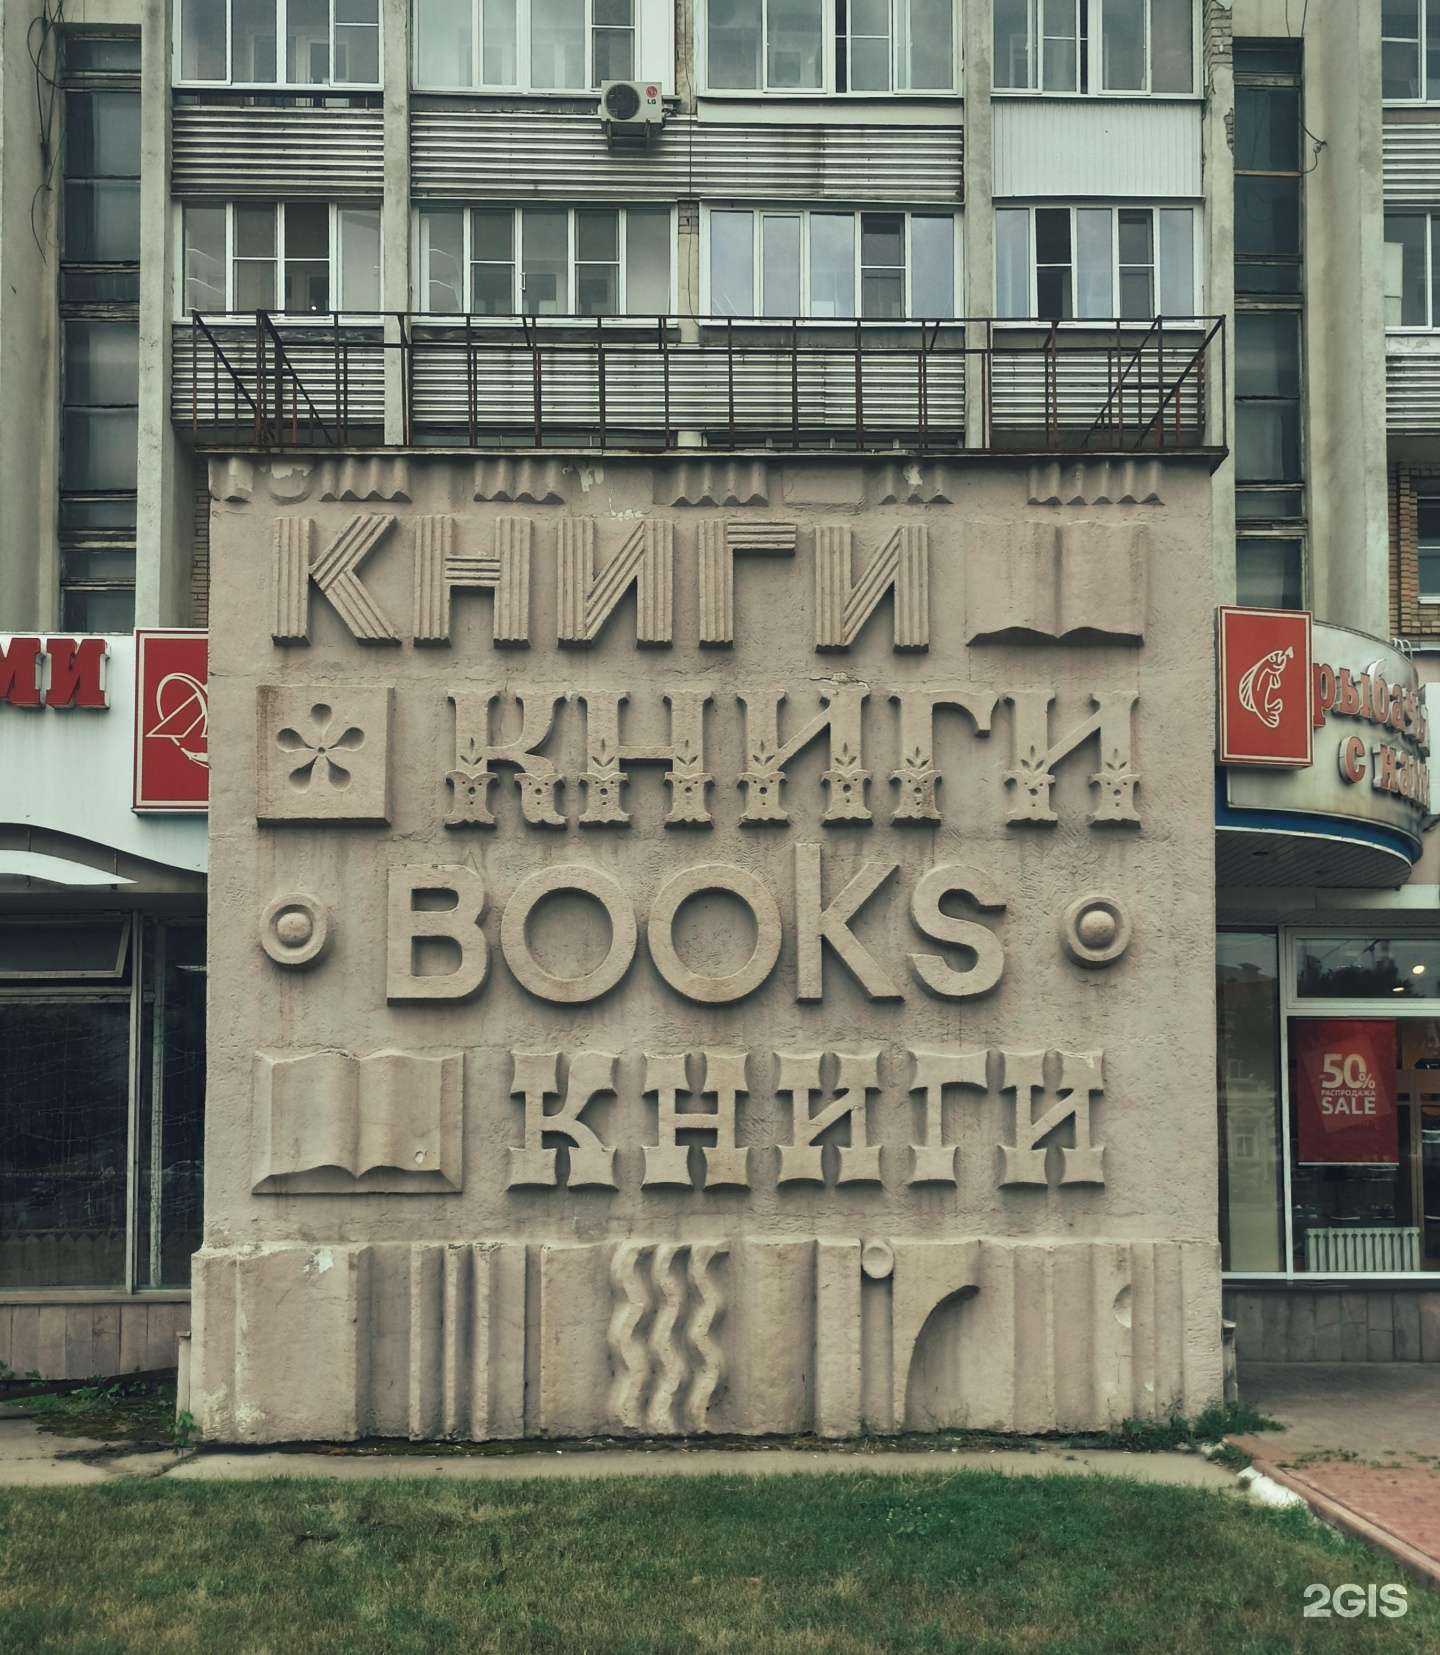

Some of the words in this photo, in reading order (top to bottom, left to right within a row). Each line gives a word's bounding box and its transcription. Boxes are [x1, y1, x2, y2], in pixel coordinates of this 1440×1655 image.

[271, 514, 930, 650] КНИГИ
[445, 688, 1141, 827] КНИГИ
[386, 842, 1007, 1004] BOOKS
[506, 1048, 1106, 1191] КНИГИ
[1321, 1097, 1377, 1115] SALE
